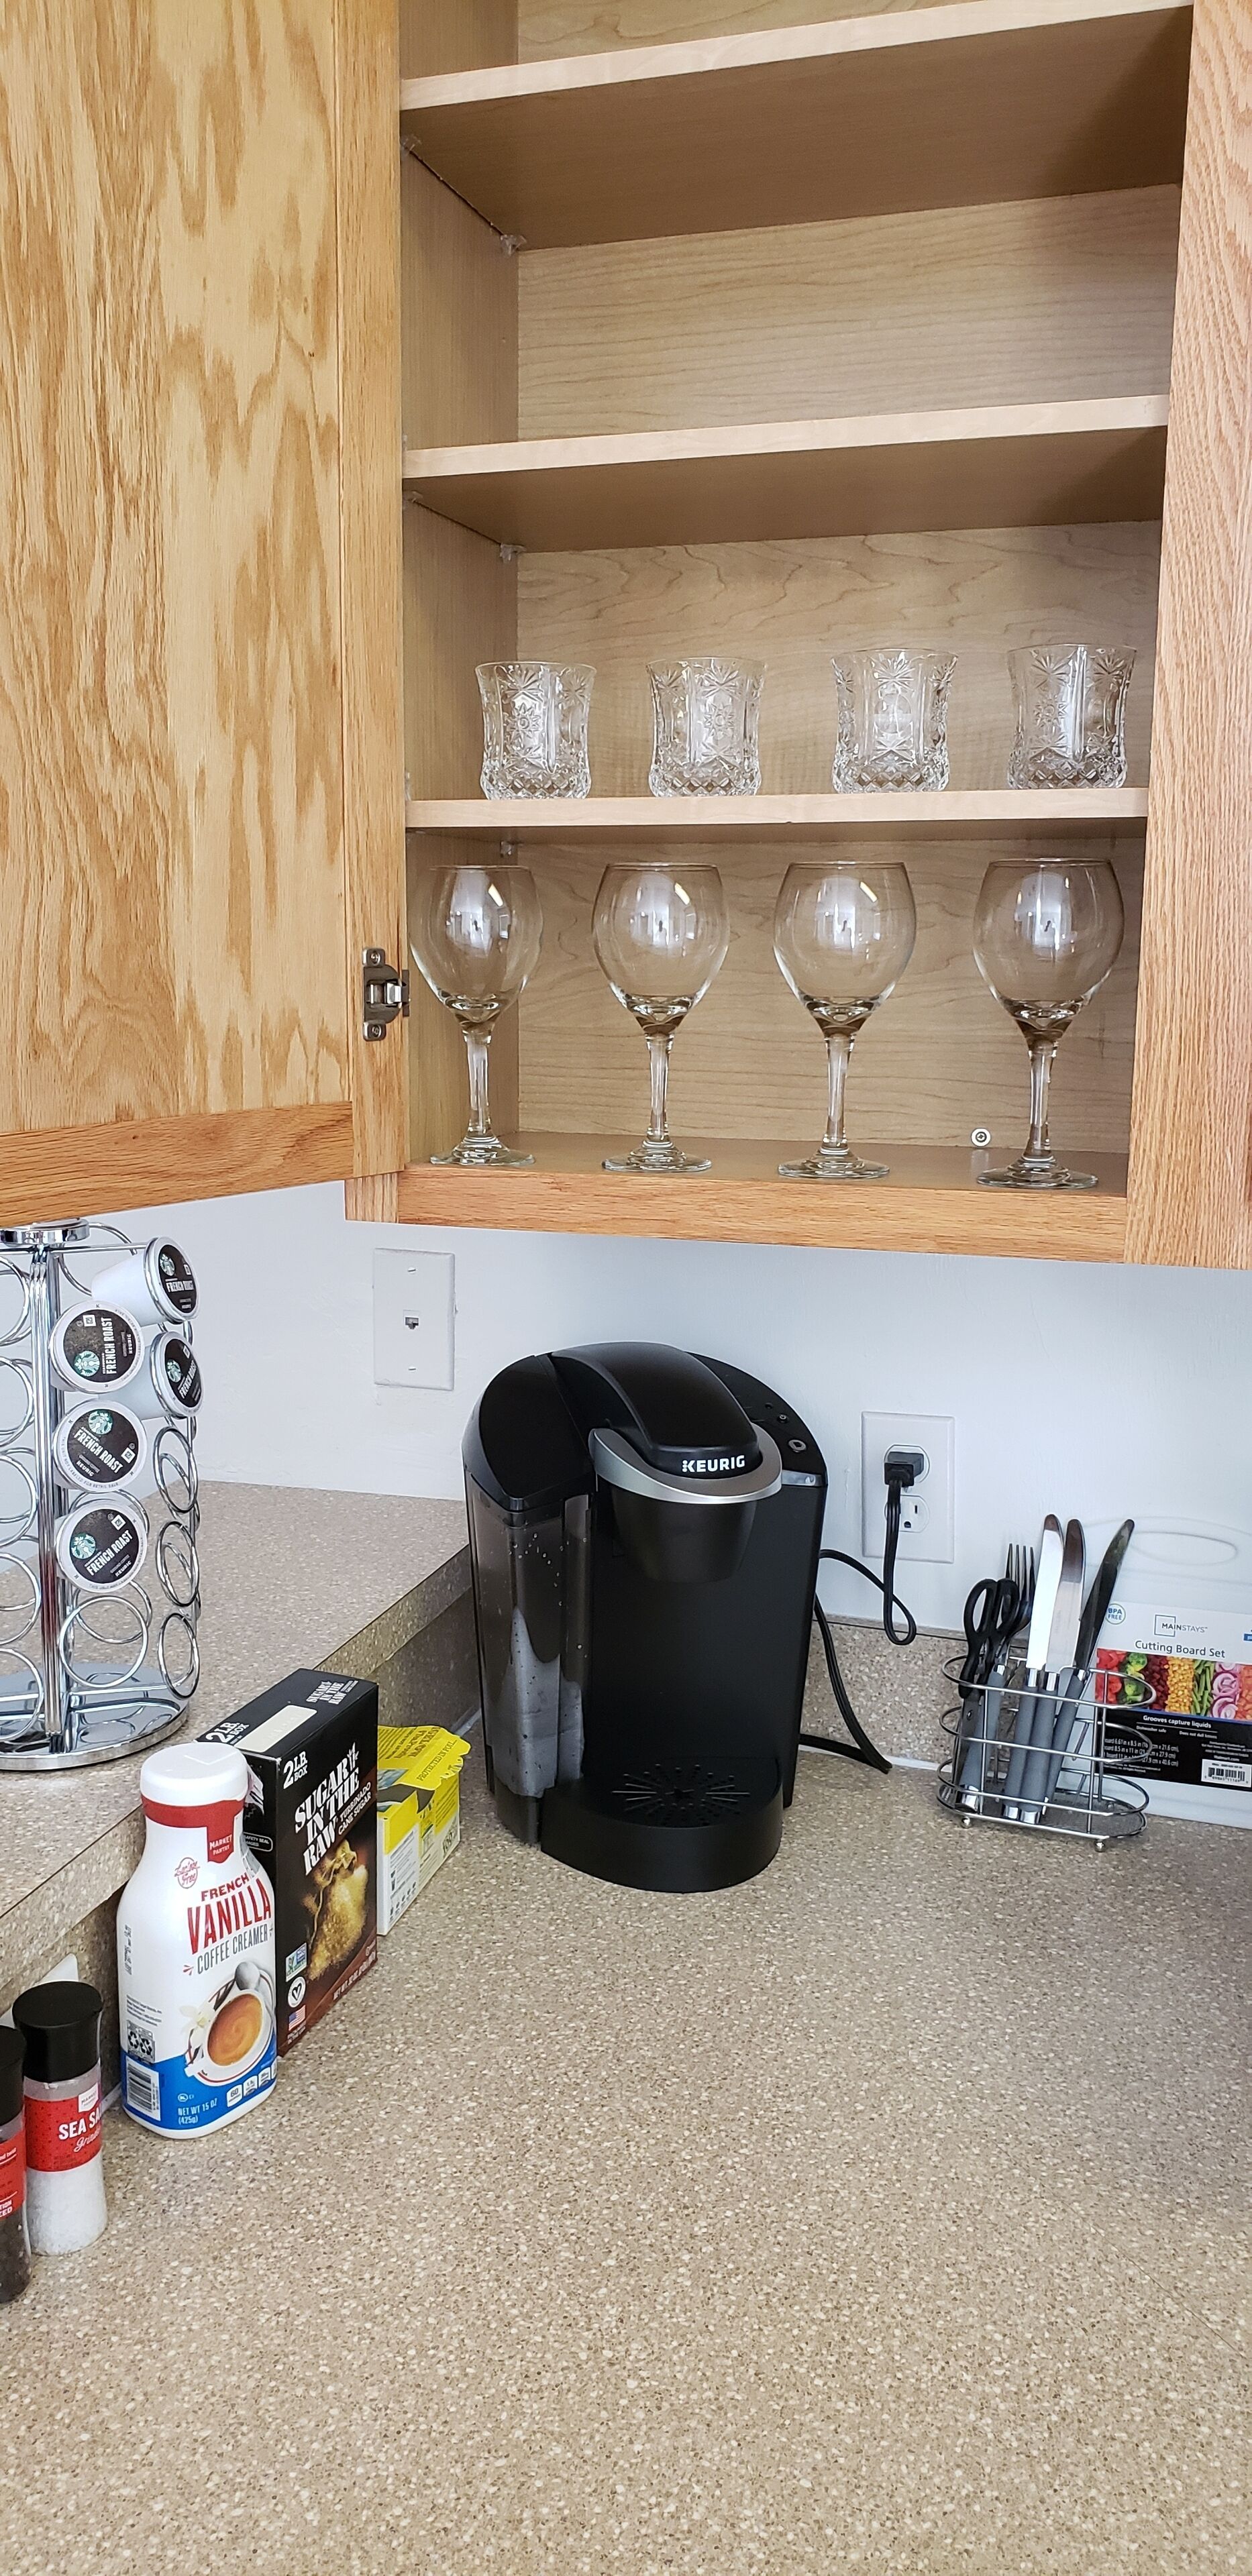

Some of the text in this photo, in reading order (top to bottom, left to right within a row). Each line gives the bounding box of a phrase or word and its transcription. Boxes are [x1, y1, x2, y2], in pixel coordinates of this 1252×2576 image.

[101, 1317, 117, 1375] FRENCH ROAST
[74, 1429, 123, 1474] FRENCH ROAST
[682, 1455, 745, 1472] KEURIG
[86, 1548, 115, 1576] FRENCH
[111, 1529, 133, 1553] ROAST
[1108, 1607, 1123, 1615] BPA
[1161, 1623, 1206, 1633] MAINSTAYS
[1135, 1640, 1226, 1658] Cutting Board Set
[229, 1723, 250, 1735] BOX
[1143, 1715, 1212, 1729] Grooves capture liquids
[205, 1732, 231, 1743] 2
[284, 1760, 294, 1789] 2
[294, 1765, 308, 1782] BOX
[295, 1758, 349, 1833] SUGAR
[340, 1782, 371, 1822] TURBINADO
[307, 1767, 359, 1845] IN THE
[338, 1791, 371, 1835] CANE SUGAR
[209, 1834, 232, 1850] MARKET
[213, 1845, 230, 1856] PANTRY
[303, 1815, 338, 1876] RAW
[201, 1872, 250, 1902] FRENCH
[187, 1878, 272, 1955] VANILLA
[197, 1923, 268, 1975] COFFEE CREAMER
[230, 2088, 239, 2098] 60
[178, 2107, 189, 2116] NET
[191, 2106, 201, 2114] WT
[202, 2103, 209, 2112] 15
[210, 2098, 218, 2108] OZ
[58, 2118, 87, 2140] SEA
[178, 2115, 199, 2125] (425g)
